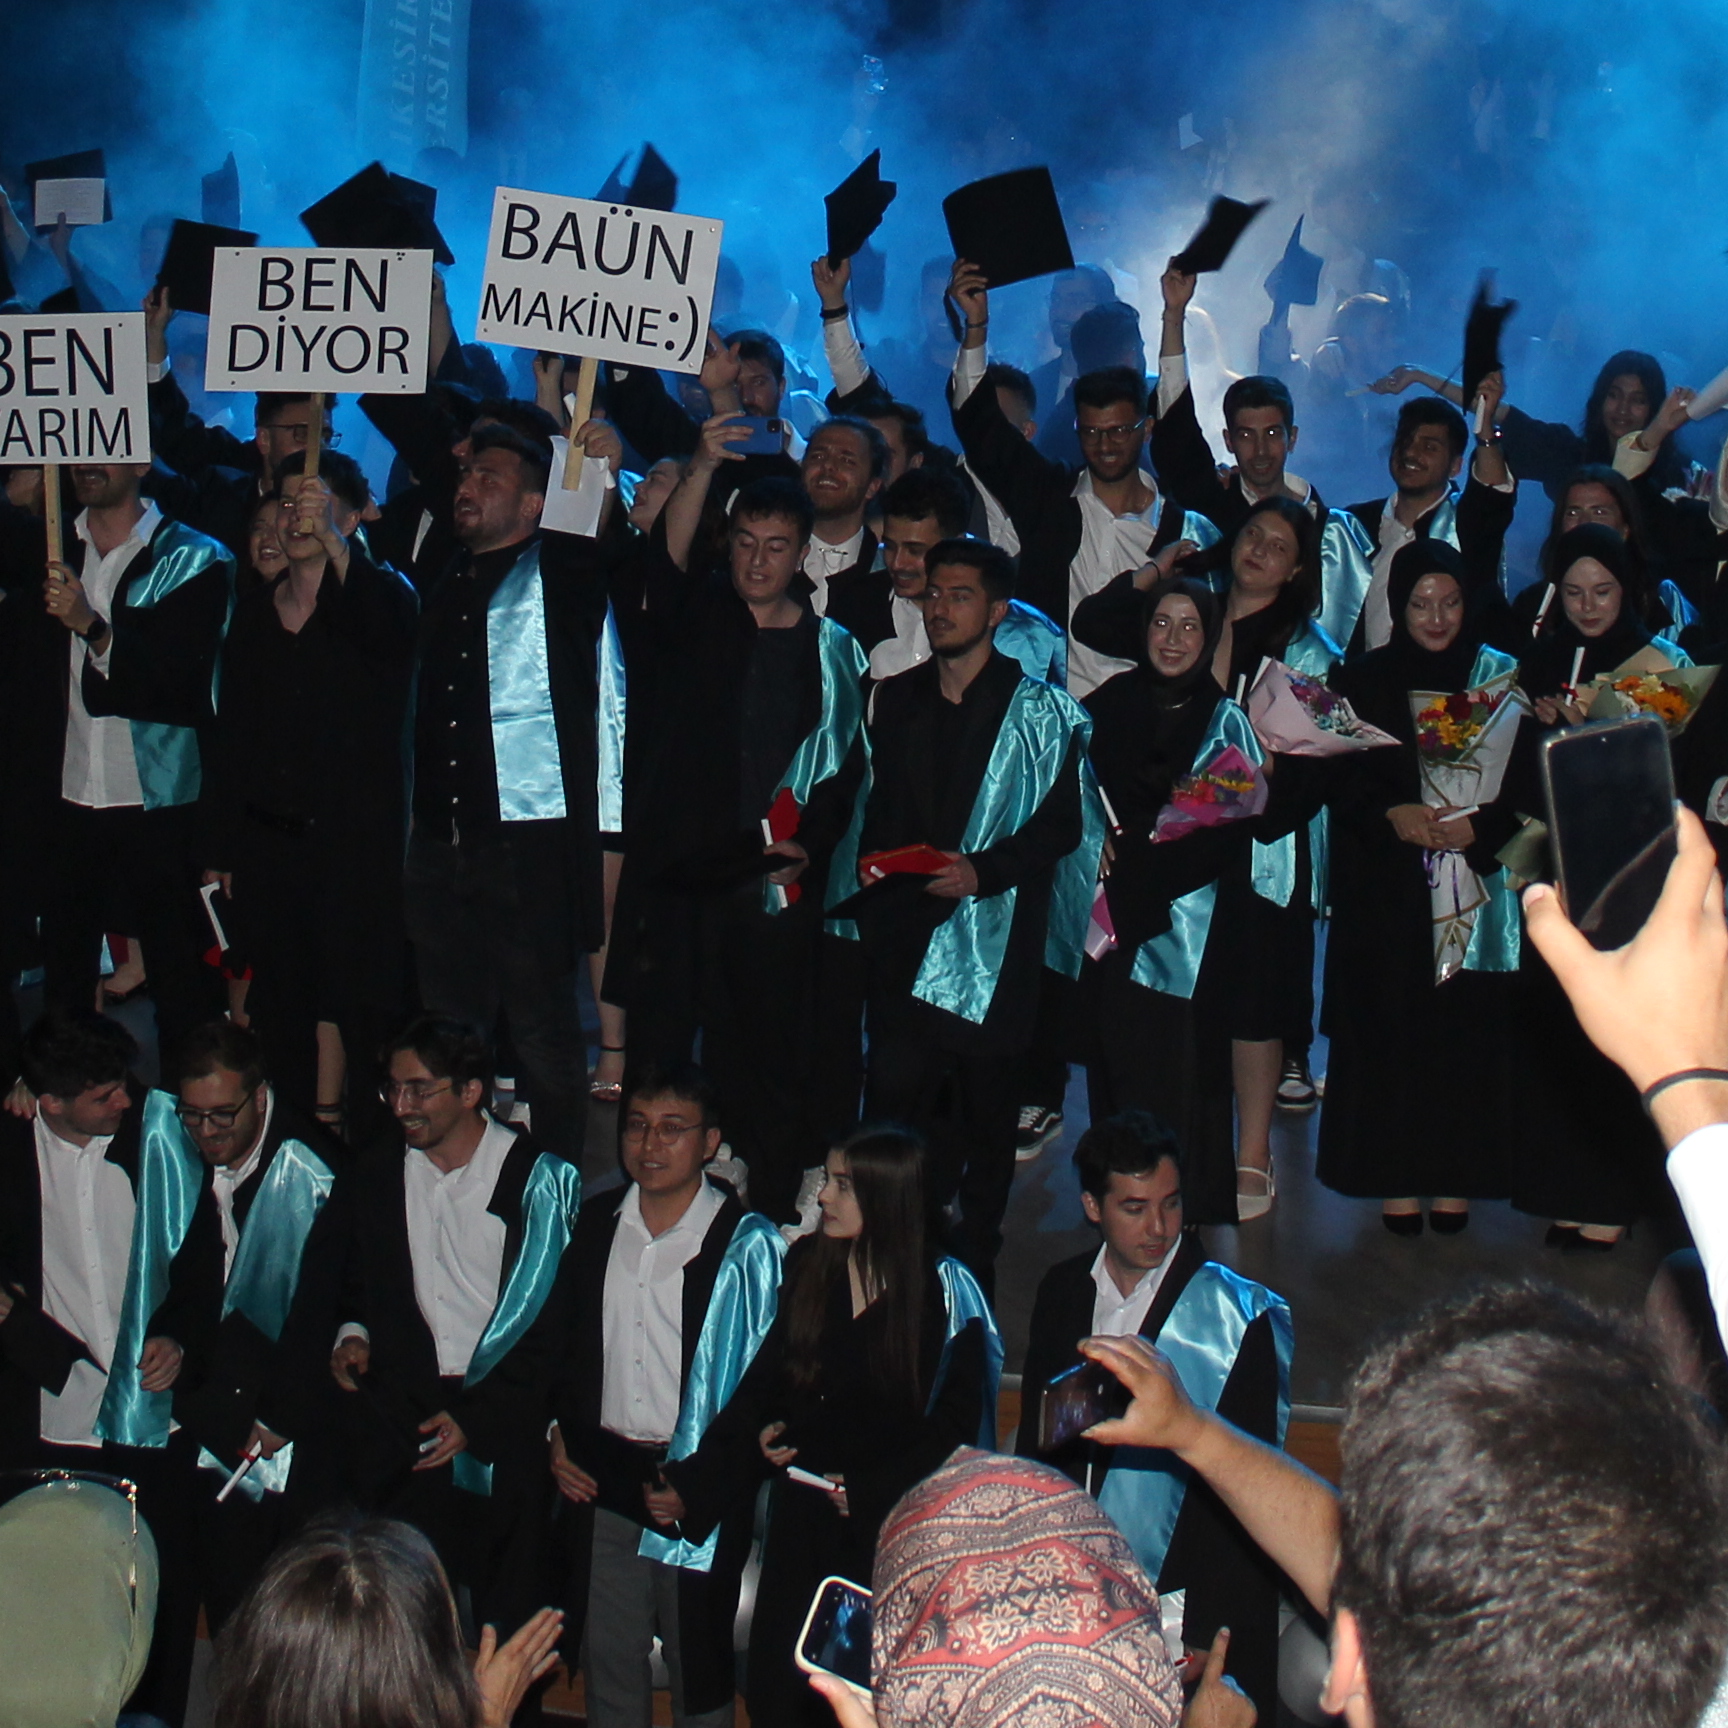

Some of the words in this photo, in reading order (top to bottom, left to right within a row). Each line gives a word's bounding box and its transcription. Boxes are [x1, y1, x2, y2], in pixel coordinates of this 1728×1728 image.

[501, 203, 694, 285] BAÜN
[259, 257, 389, 313] BEN
[227, 315, 410, 374] DİYOR
